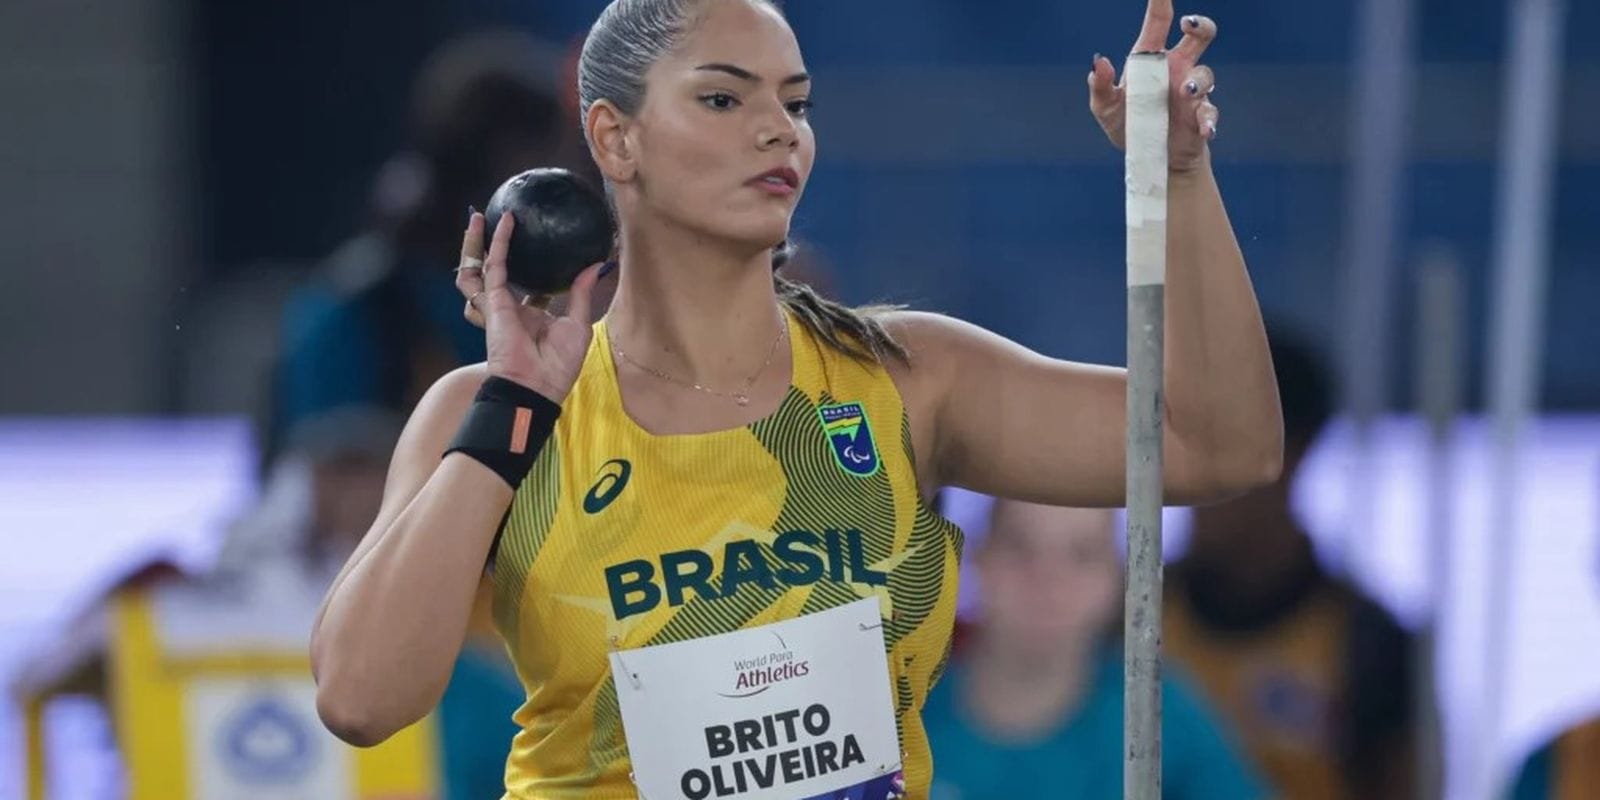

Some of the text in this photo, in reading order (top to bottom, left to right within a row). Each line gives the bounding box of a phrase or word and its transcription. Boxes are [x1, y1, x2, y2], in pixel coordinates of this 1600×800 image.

[823, 406, 860, 416] BRASIL
[604, 528, 887, 621] BRASIL
[734, 651, 793, 671] World Para
[736, 661, 809, 690] Athletics
[704, 703, 831, 759] BRITO
[680, 733, 866, 800] OLIVEIRA
